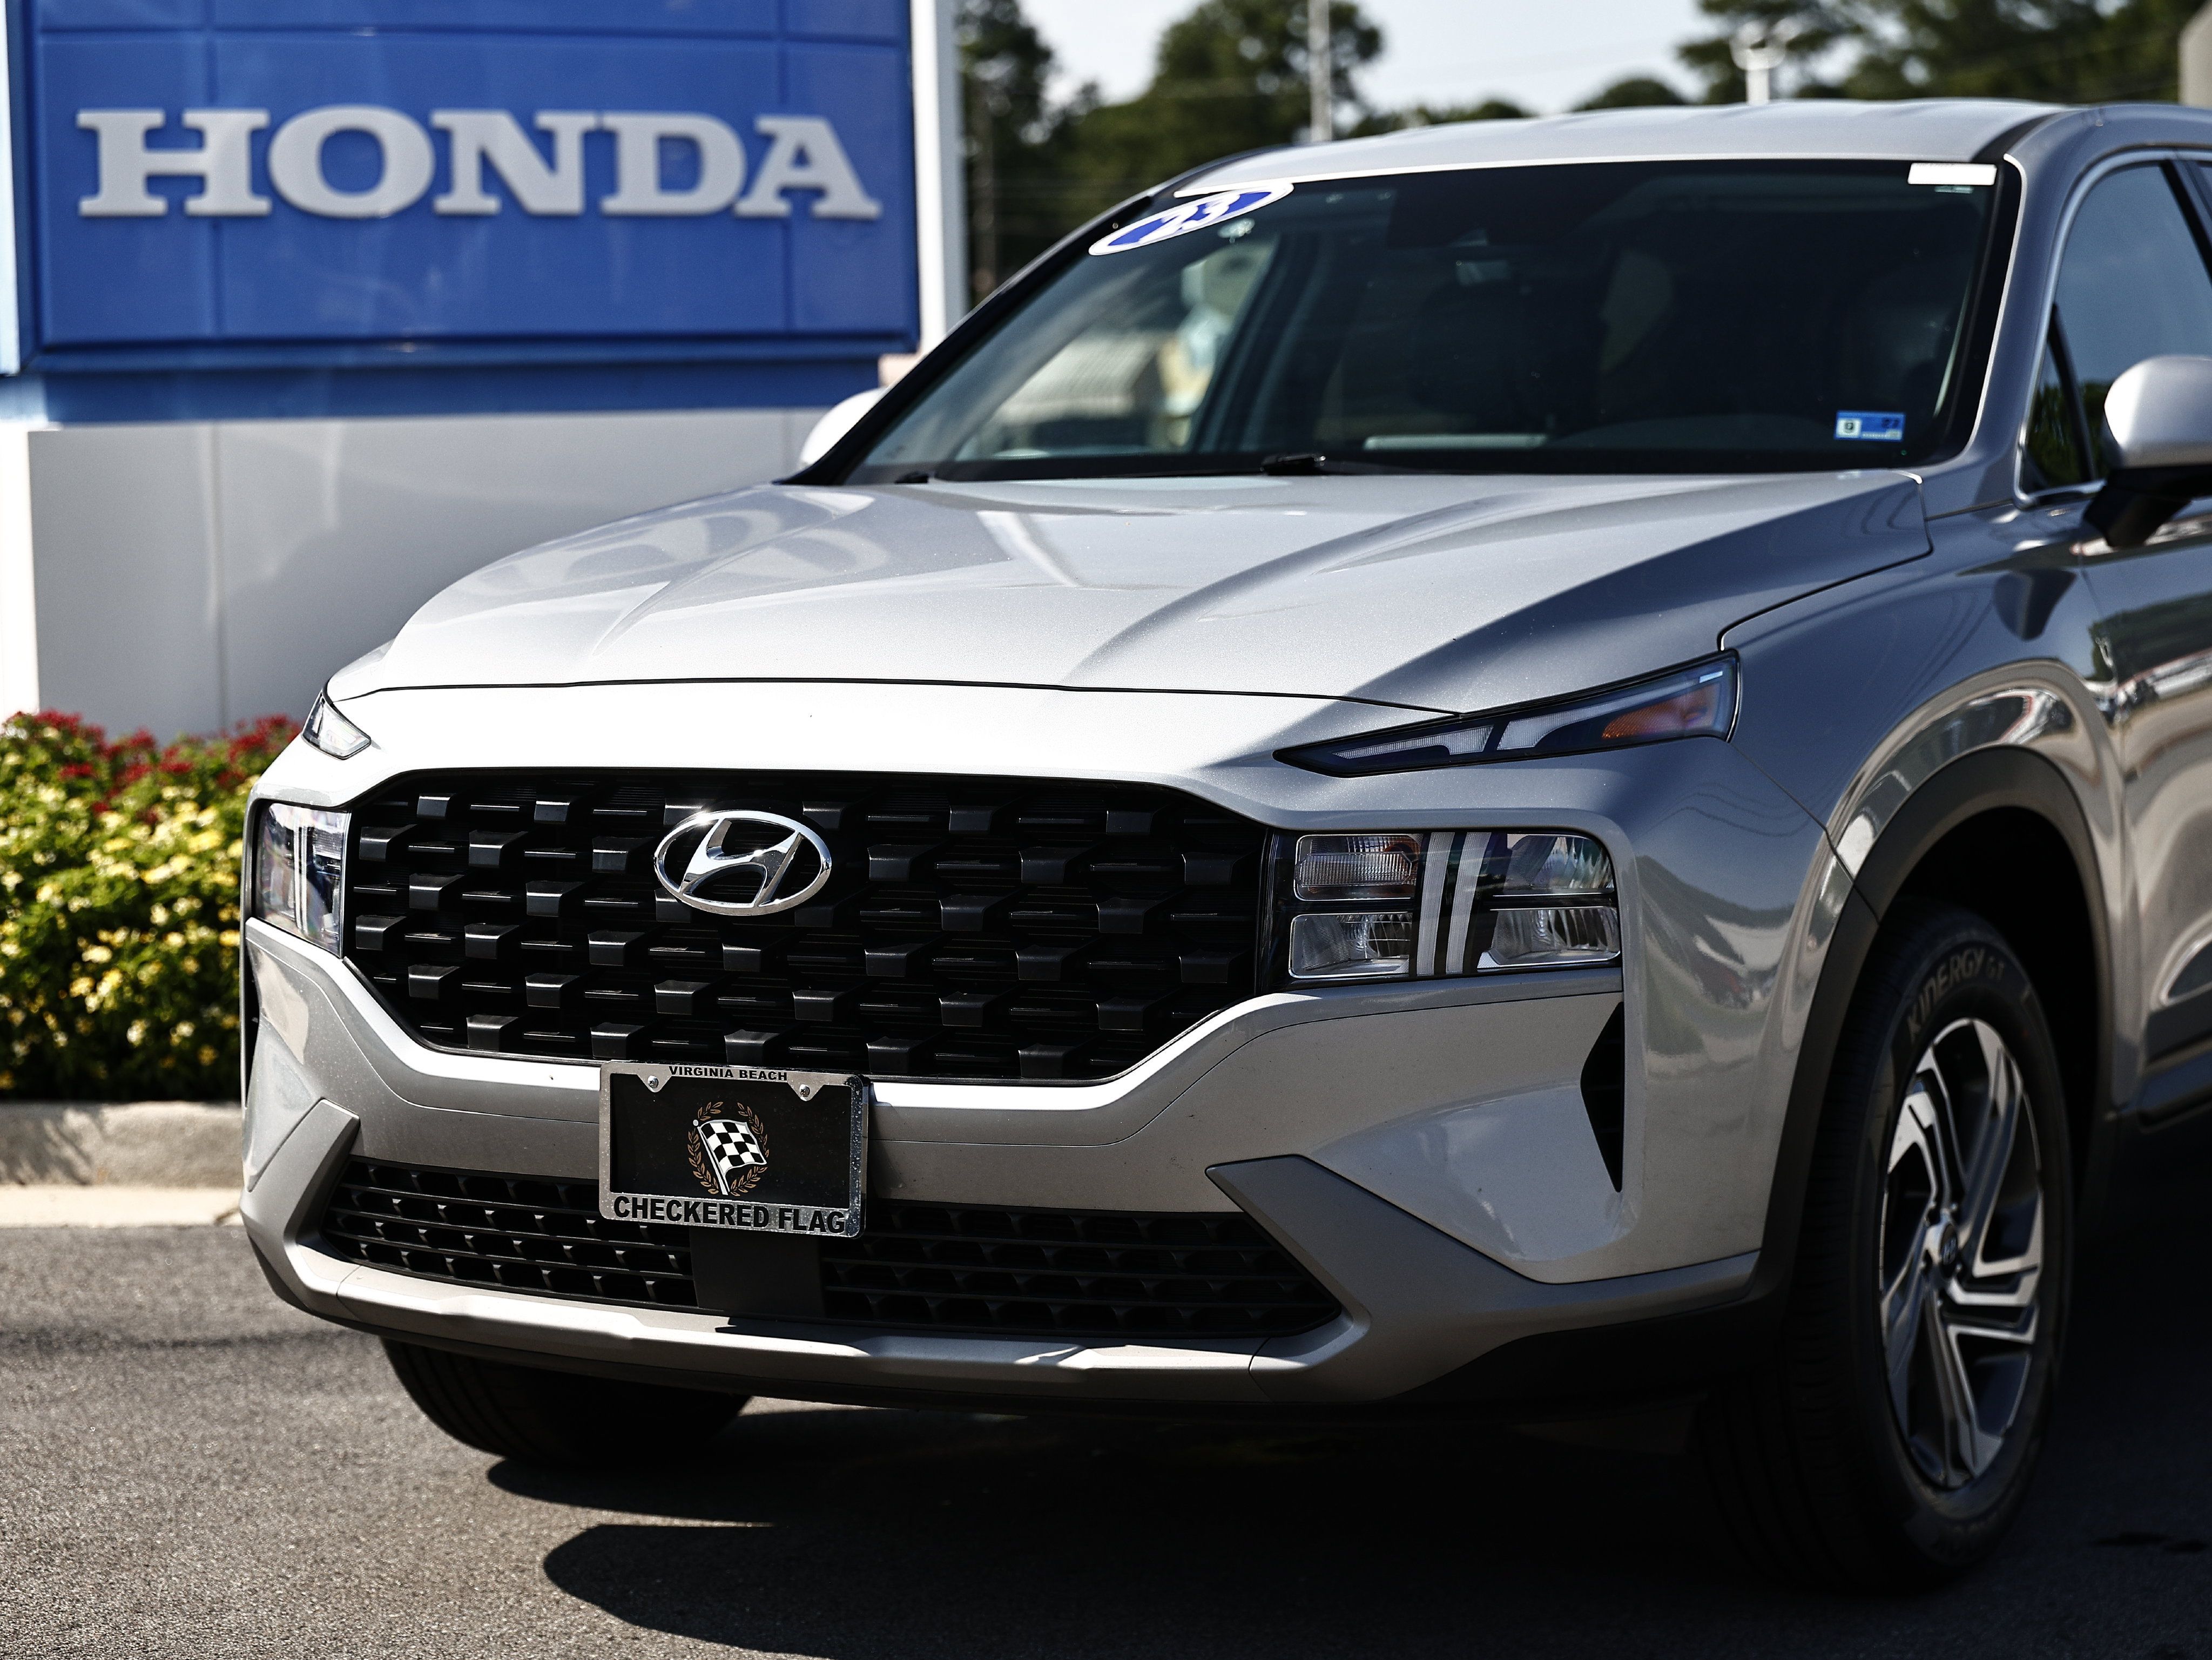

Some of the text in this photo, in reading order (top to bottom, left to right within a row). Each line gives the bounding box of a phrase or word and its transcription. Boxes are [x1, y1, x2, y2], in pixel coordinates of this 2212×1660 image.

[77, 105, 879, 217] HONDA
[669, 1066, 787, 1081] VIRGINIA BEACH
[614, 1196, 845, 1234] CHECKERED FLAG
